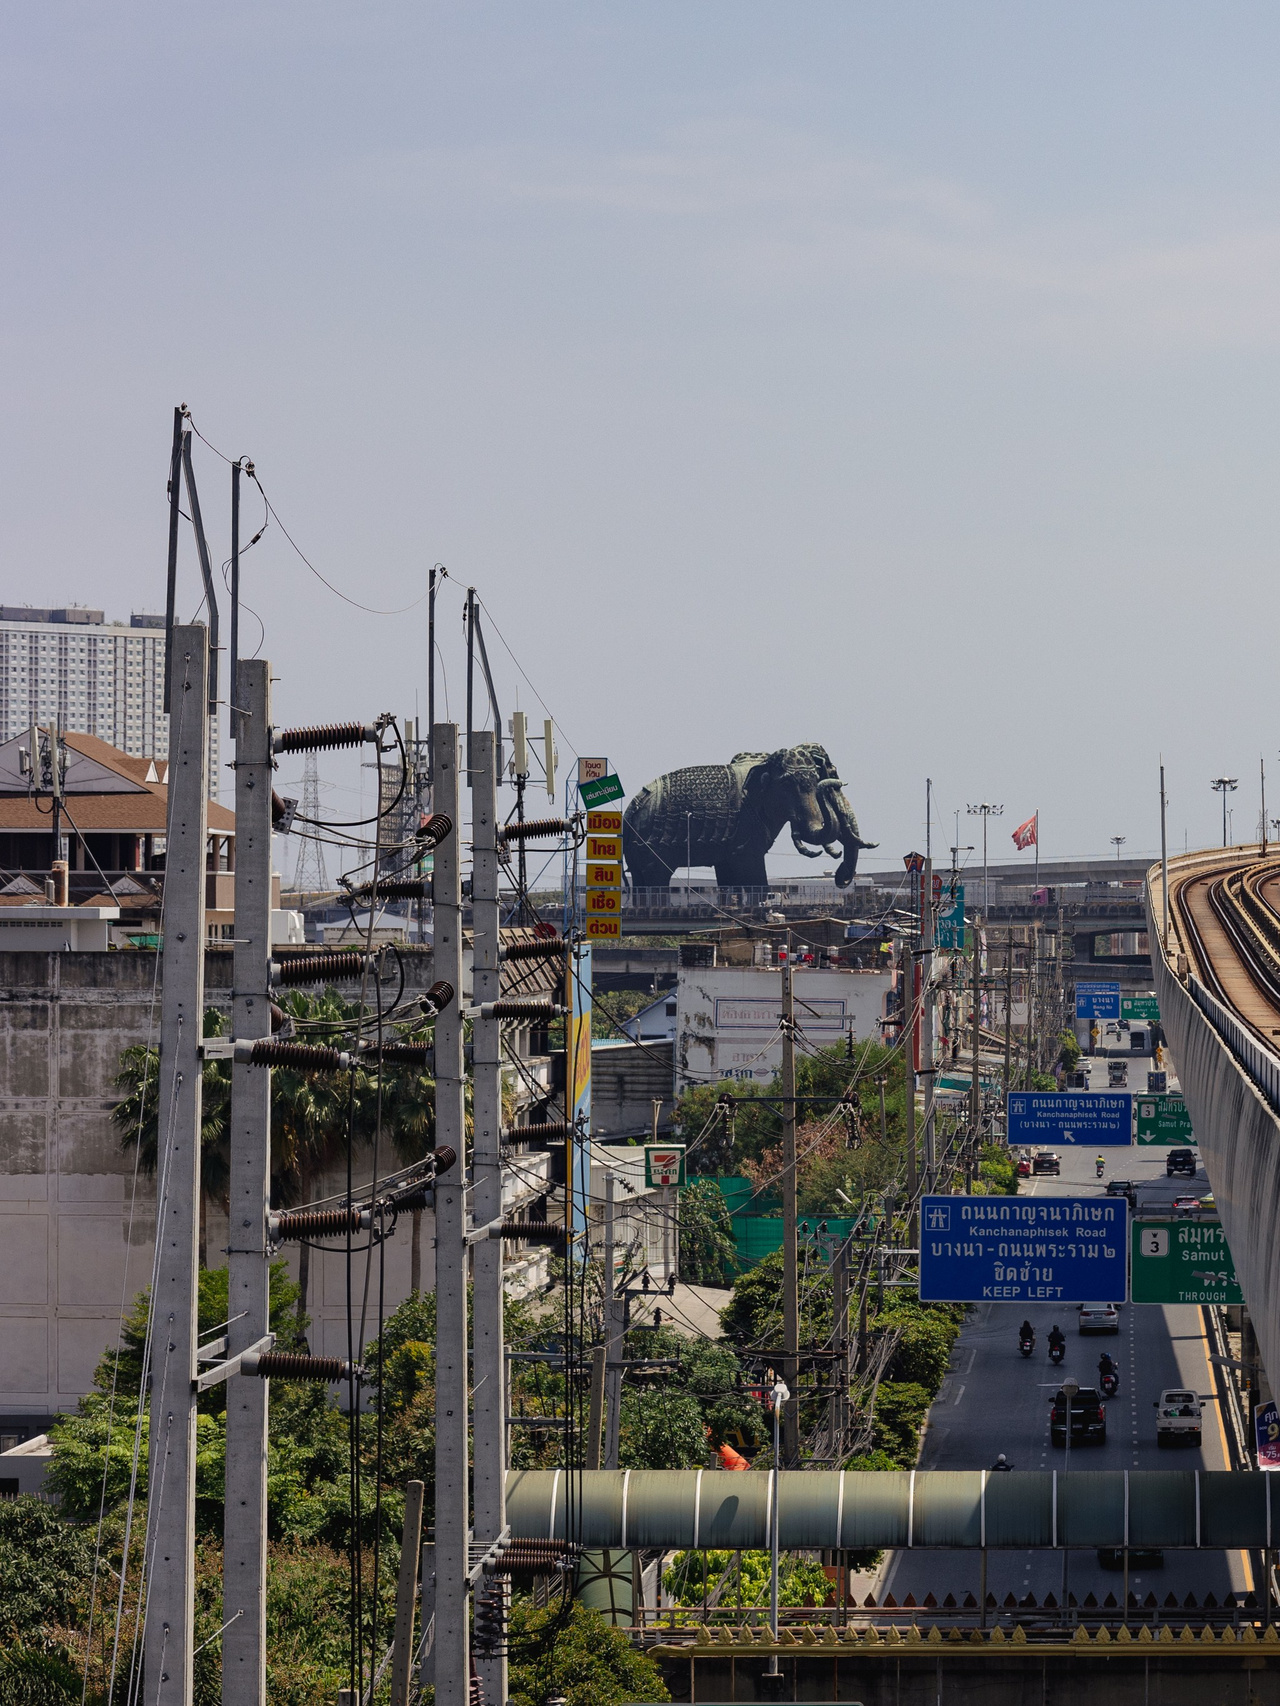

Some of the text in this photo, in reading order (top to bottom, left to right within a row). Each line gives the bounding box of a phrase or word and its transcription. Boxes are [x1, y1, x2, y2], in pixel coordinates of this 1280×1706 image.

[588, 814, 621, 831] เมือง
[591, 839, 616, 856] ไทย
[594, 867, 614, 882] สิน
[591, 891, 616, 910] เชื่อ
[589, 919, 618, 935] ด่วน
[1032, 1097, 1125, 1111] ถนนกาญจนาภิเษก
[1036, 1111, 1120, 1120] Kanchanaphisek Road
[1145, 1109, 1151, 1117] 3
[1158, 1120, 1193, 1128] Samut Pra
[961, 1203, 1115, 1225] ถนนกาญจนาภิเษก
[969, 1226, 1107, 1239] Kanchanaphisek Road
[1150, 1241, 1160, 1253] 3
[1181, 1250, 1225, 1261] Samut
[993, 1261, 1053, 1282] ชิดซ้าย
[983, 1286, 1064, 1298] KEEP LEFT
[1178, 1291, 1226, 1301] THROUGH
[1260, 1450, 1277, 1459] 1.75
